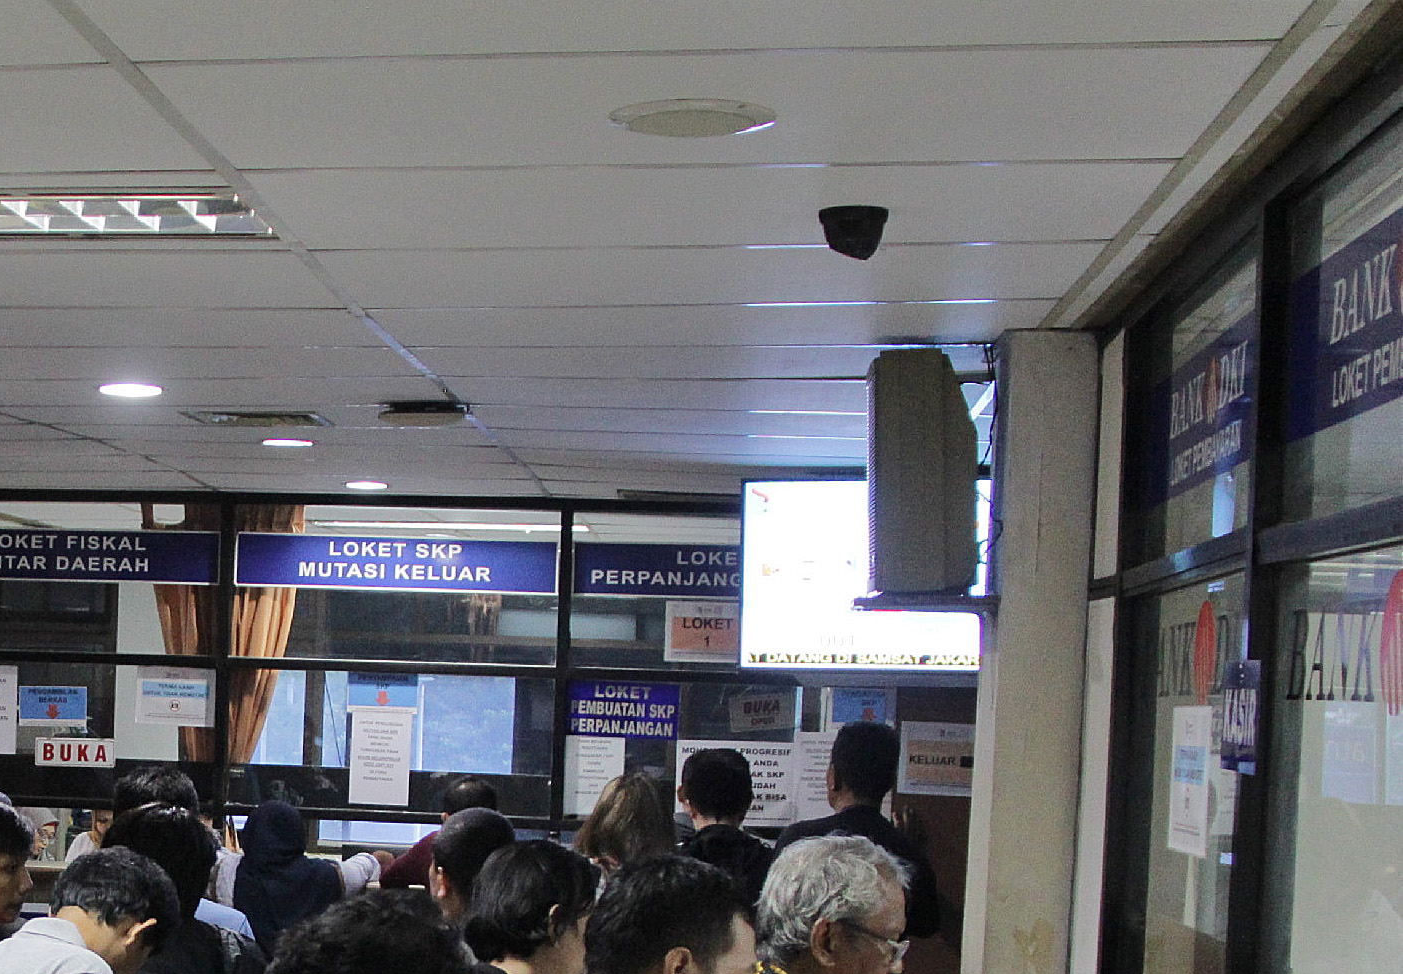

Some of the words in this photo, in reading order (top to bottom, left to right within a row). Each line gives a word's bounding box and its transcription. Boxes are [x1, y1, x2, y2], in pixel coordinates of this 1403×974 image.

[1330, 243, 1397, 345] BANK
[1332, 353, 1372, 408] LOKET
[1170, 372, 1207, 440] BANK
[67, 536, 146, 551] FISKAL
[329, 541, 406, 557] LOKET
[416, 543, 462, 559] SKP
[56, 556, 149, 572] DAERAH
[298, 561, 385, 579] MUTASI
[394, 564, 491, 581] KELUAR
[683, 617, 733, 629] LOKET
[704, 636, 710, 646] 1
[769, 653, 832, 663] DATANG
[837, 653, 850, 664] DI
[858, 654, 923, 665] SAMSAT
[1286, 605, 1378, 701] BANK
[594, 685, 652, 700] LOKET
[571, 700, 645, 717] PEMBUATAN
[649, 704, 675, 719] SKP
[743, 701, 781, 714] BUKA
[1222, 688, 1257, 747] KASIR
[571, 718, 673, 737] PERPANJANGAN
[43, 743, 107, 762] BUKA
[740, 748, 792, 756] PROGRESIF
[909, 755, 957, 766] KELUAR
